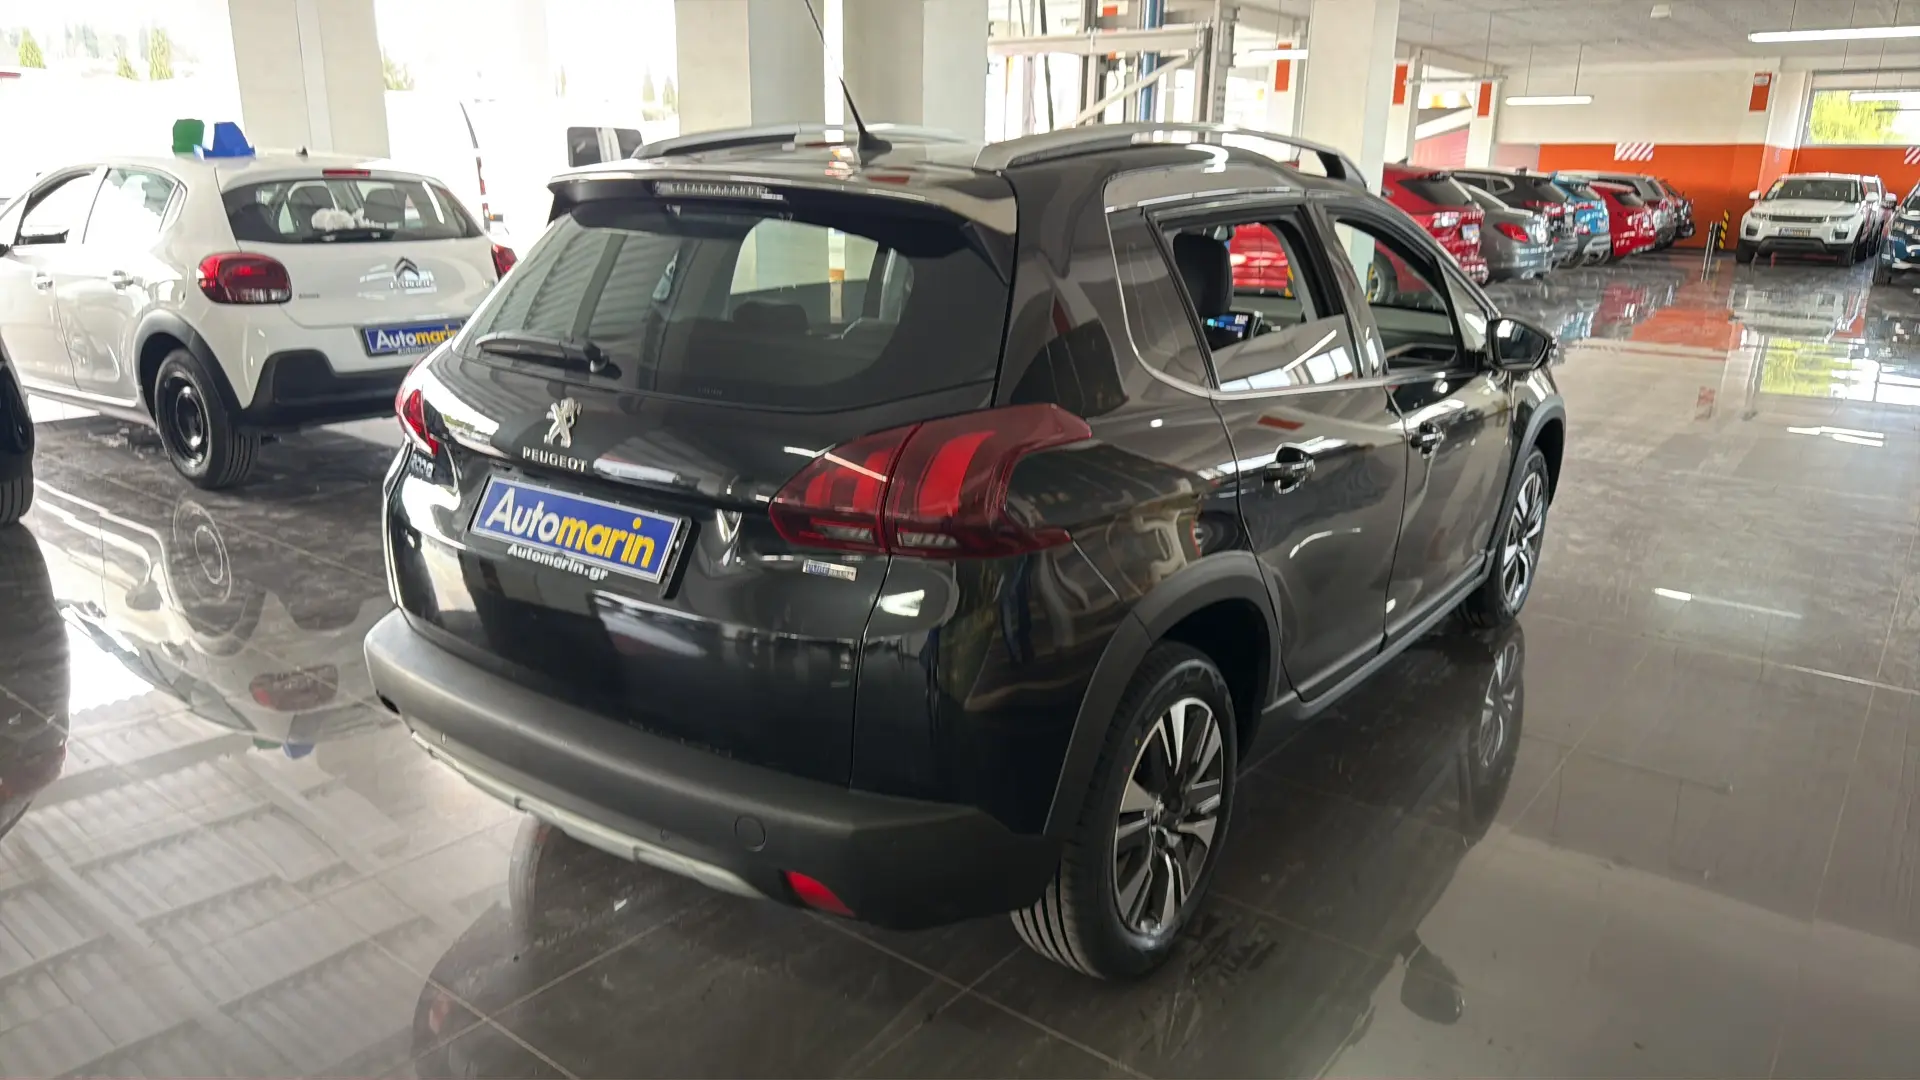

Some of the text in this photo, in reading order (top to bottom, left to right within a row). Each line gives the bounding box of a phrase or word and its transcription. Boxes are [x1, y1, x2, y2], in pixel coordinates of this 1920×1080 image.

[522, 445, 588, 473] PEUGEOT
[484, 487, 655, 569] Automarin
[507, 543, 609, 581] Automarin.gr
